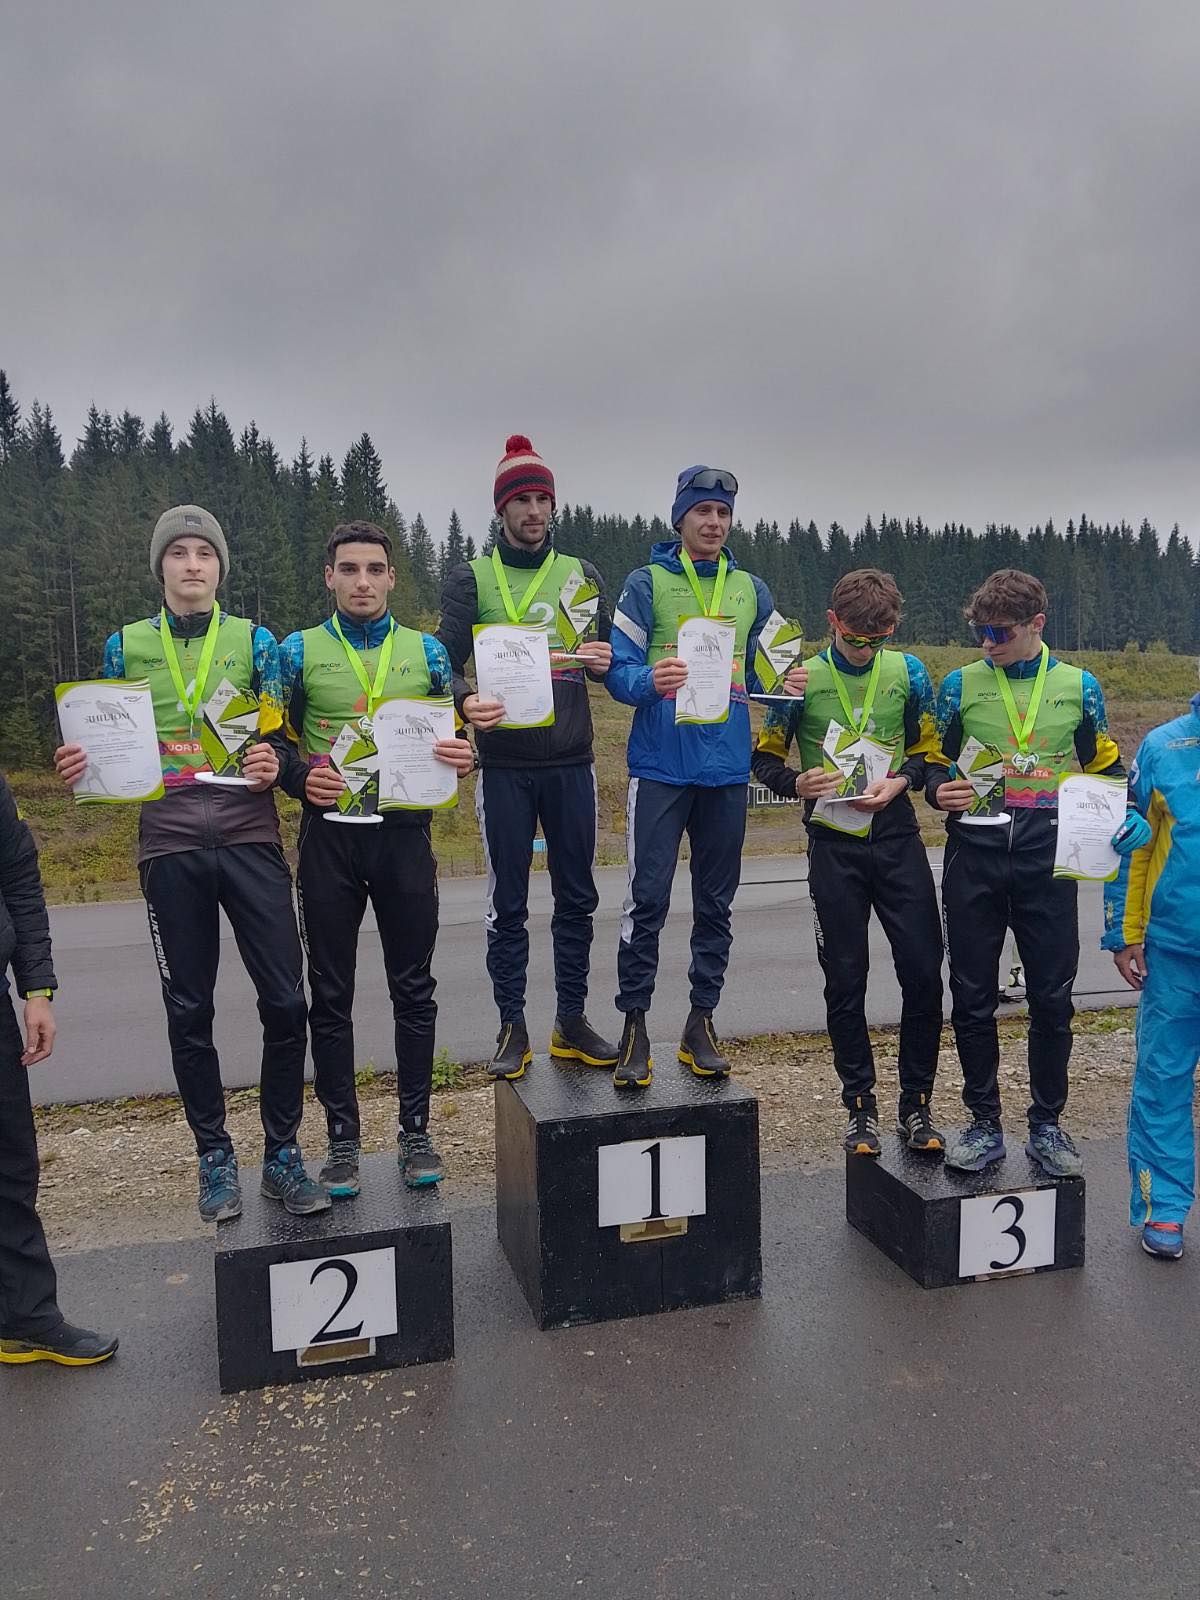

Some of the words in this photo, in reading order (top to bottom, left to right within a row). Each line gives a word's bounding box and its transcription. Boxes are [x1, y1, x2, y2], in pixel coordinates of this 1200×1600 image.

[529, 602, 557, 635] 2
[589, 620, 598, 634] 1
[857, 763, 865, 776] 3
[367, 780, 378, 794] 2
[993, 785, 1004, 798] 3
[640, 1141, 670, 1220] 1
[989, 1194, 1028, 1270] 3
[308, 1257, 365, 1344] 2
